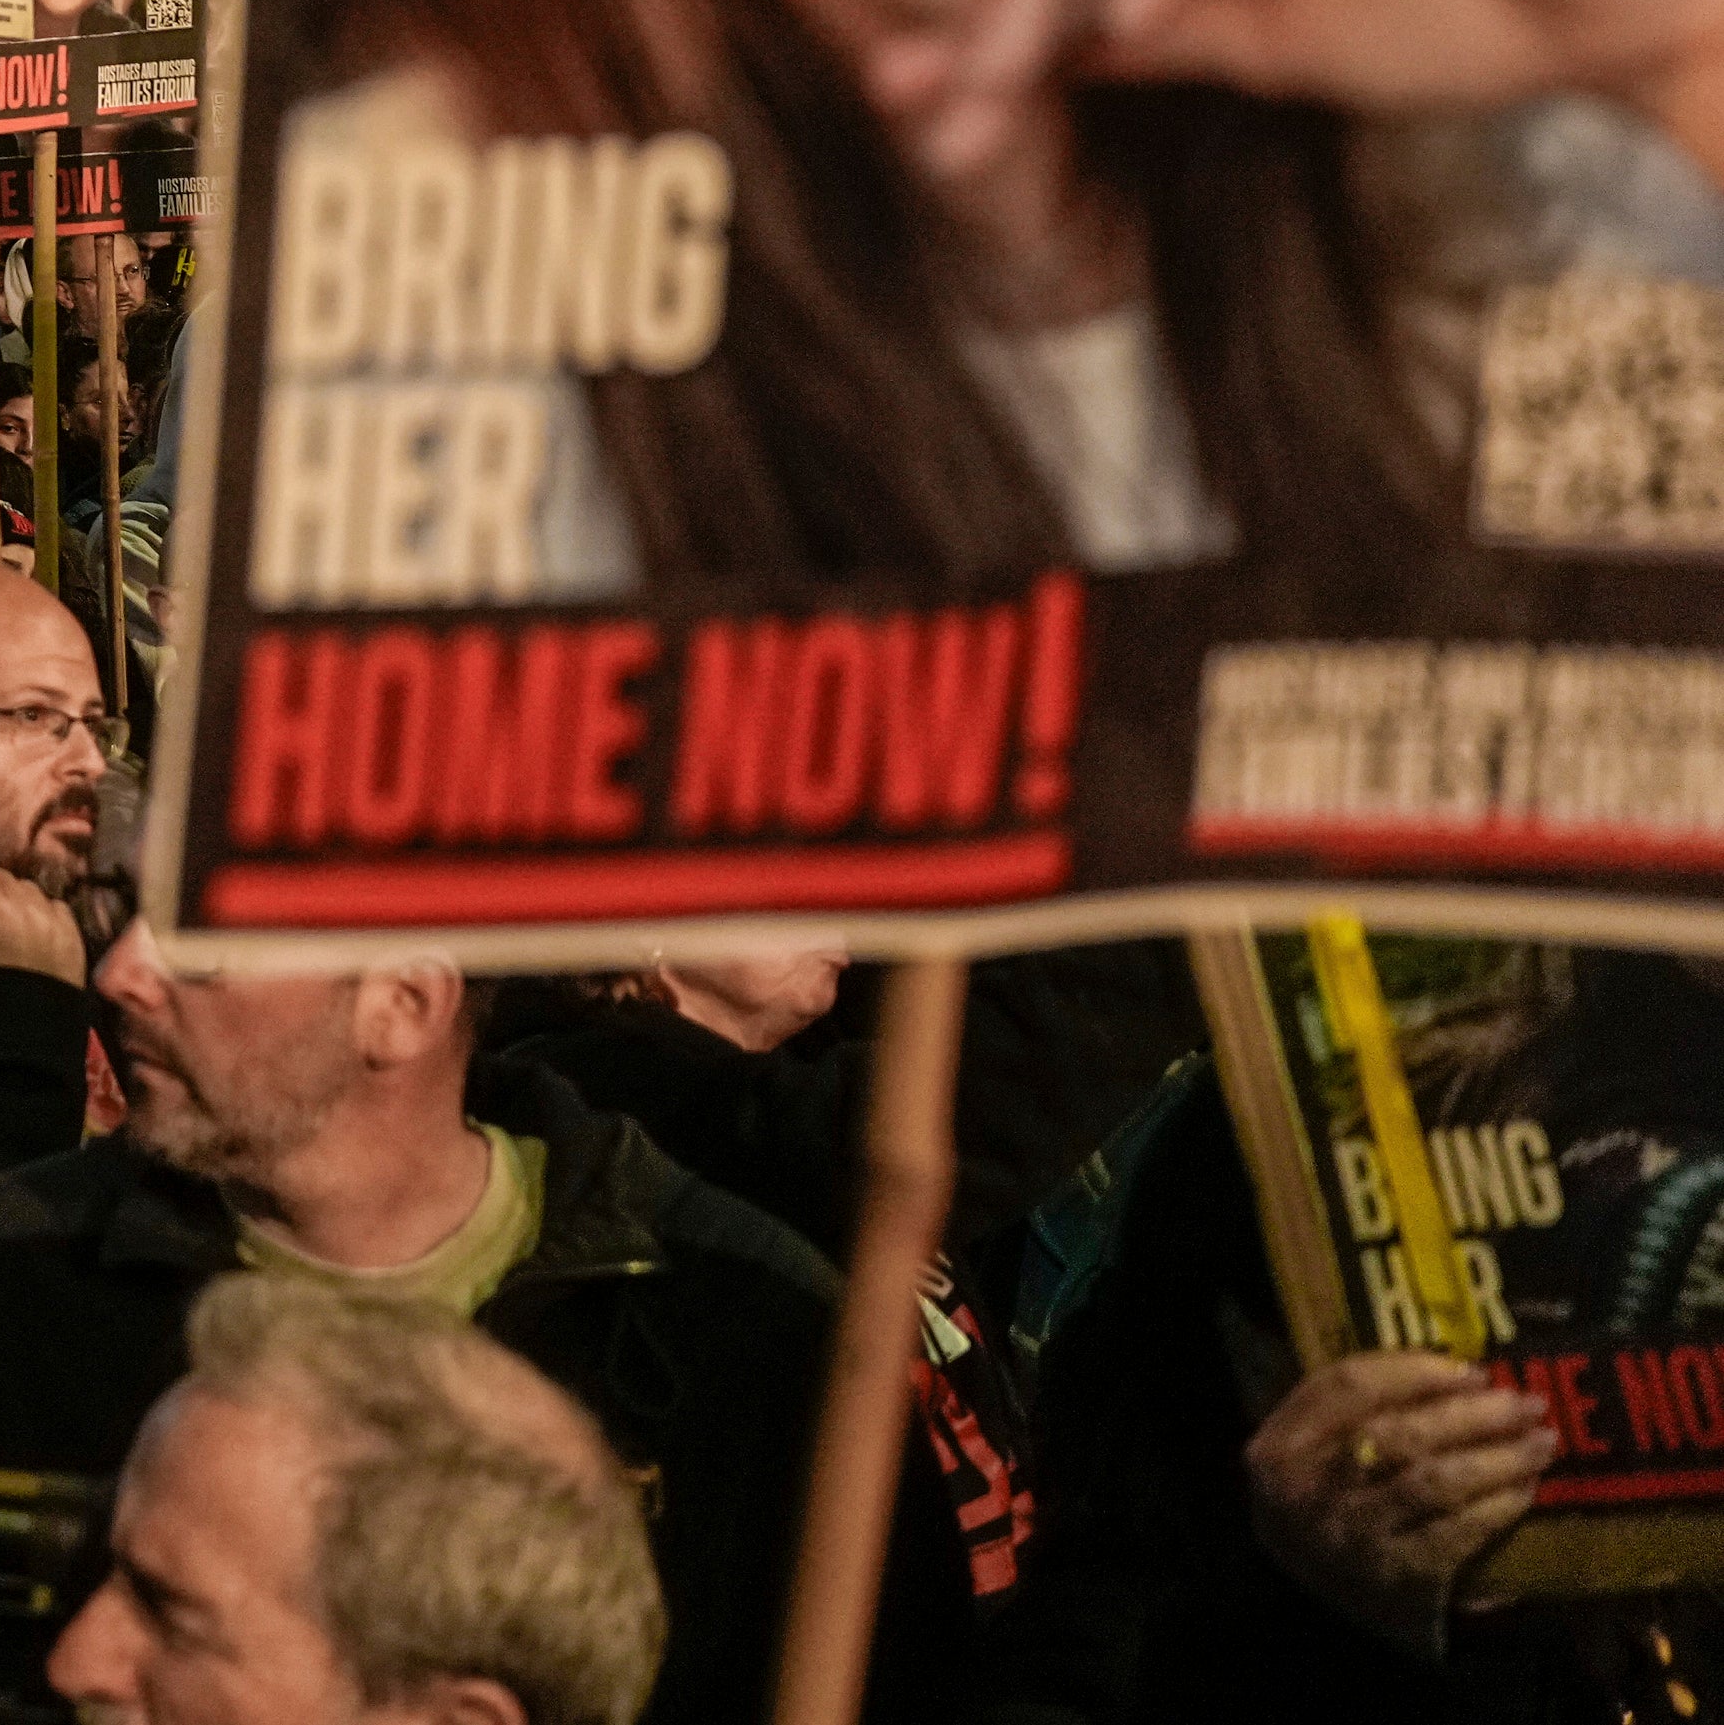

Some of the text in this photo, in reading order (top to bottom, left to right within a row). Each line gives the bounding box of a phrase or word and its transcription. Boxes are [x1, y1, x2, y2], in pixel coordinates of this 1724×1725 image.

[97, 59, 196, 82] HOSTAGES AND MISSING
[97, 76, 196, 109] FAMILIES FORUM
[27, 158, 123, 218] OW!
[277, 132, 735, 376] BRING
[249, 378, 545, 608] HER
[228, 617, 661, 846] HOME
[671, 565, 1087, 840] NOW!
[1332, 1118, 1564, 1240] BING
[1361, 1238, 1517, 1350] HR
[1614, 1344, 1724, 1453] NO
